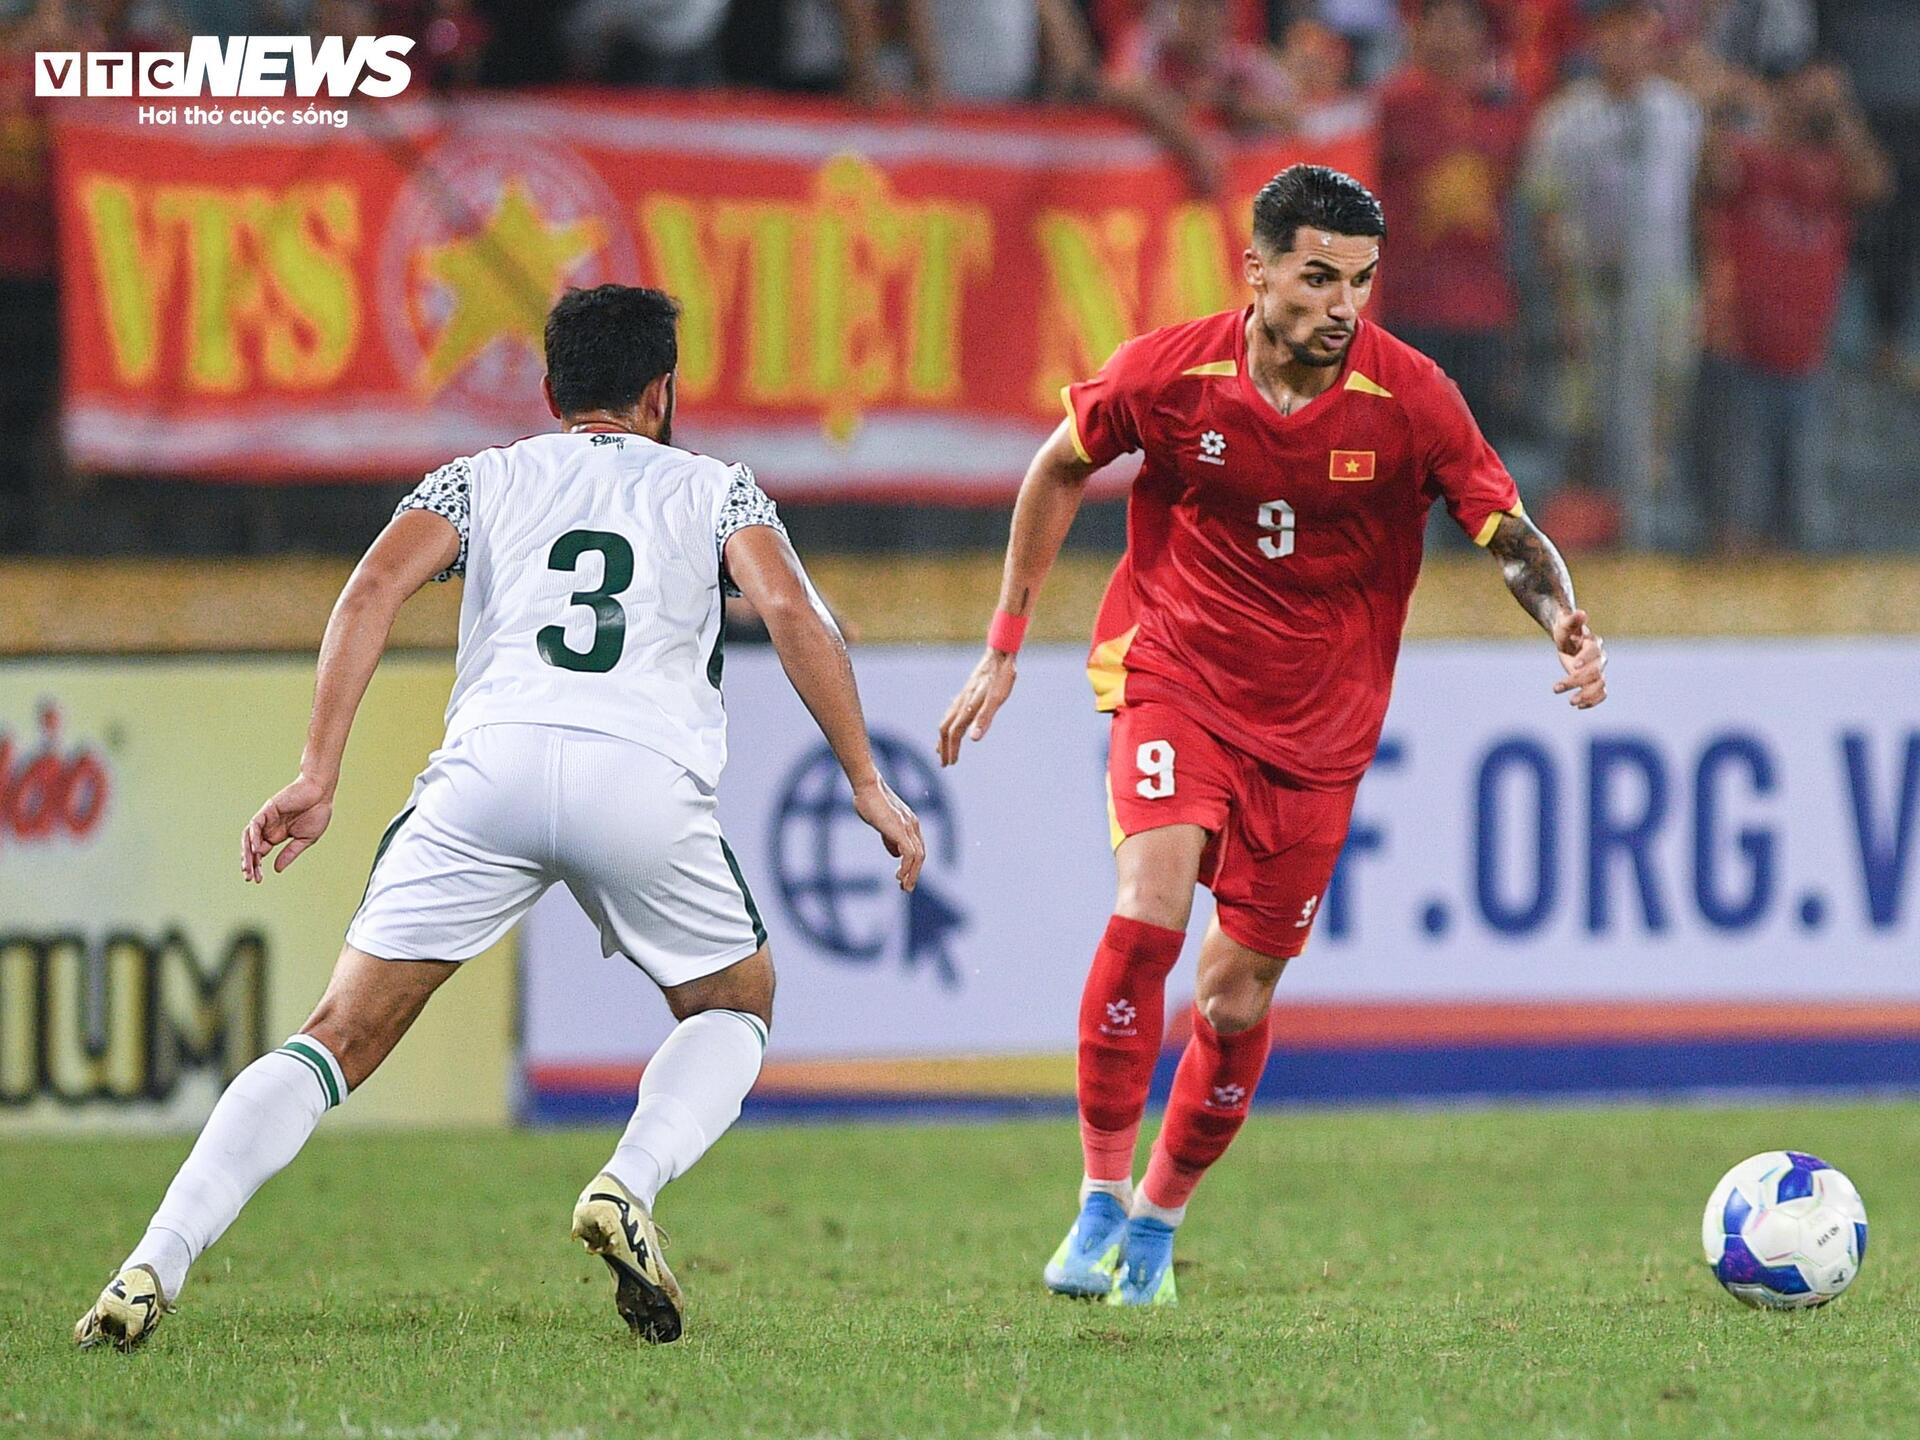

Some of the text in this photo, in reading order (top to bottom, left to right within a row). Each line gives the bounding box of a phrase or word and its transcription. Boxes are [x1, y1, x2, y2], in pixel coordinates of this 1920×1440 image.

[642, 146, 995, 447] VIỆT
[1034, 203, 1254, 414] NA
[1257, 499, 1296, 560] 9
[536, 529, 635, 673] 3
[1135, 739, 1176, 800] 9
